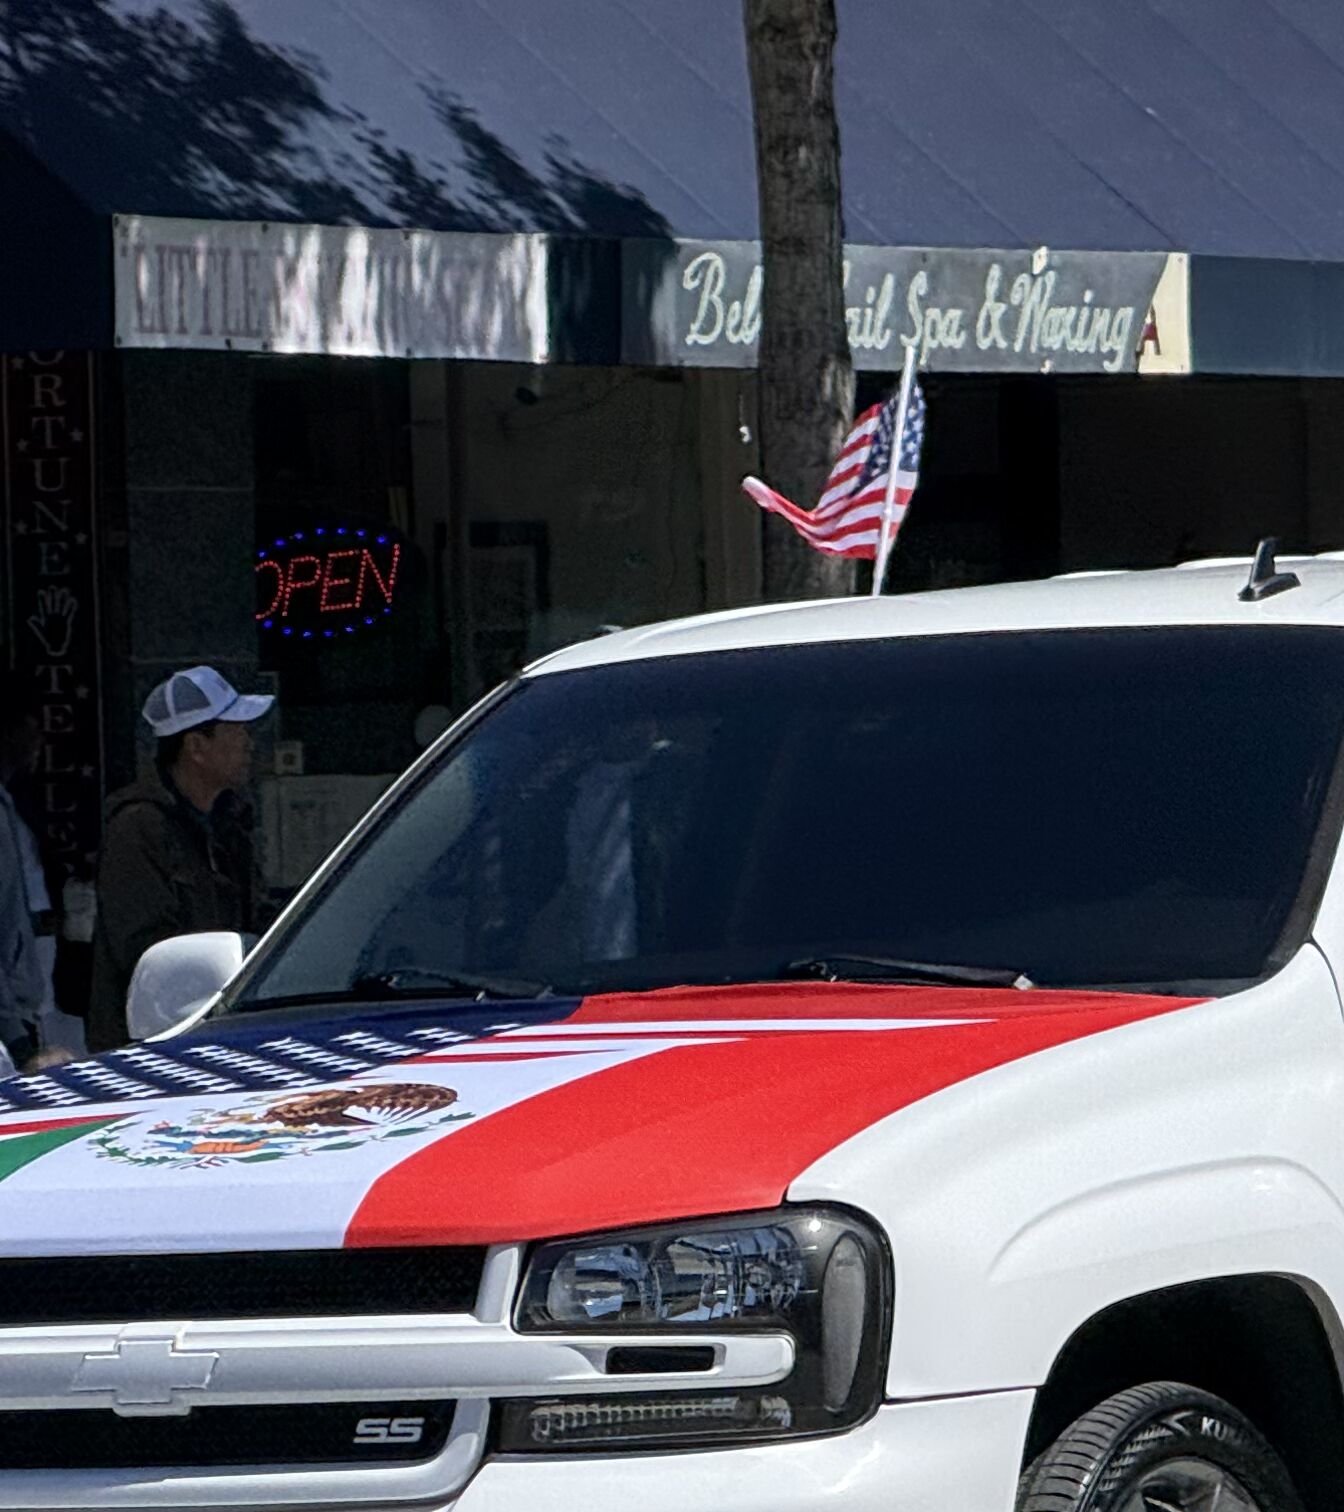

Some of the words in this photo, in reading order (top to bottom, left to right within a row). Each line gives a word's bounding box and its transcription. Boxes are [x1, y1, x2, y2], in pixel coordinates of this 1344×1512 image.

[683, 251, 762, 346] Bel
[842, 260, 896, 351] ail
[900, 269, 966, 368] Spa
[975, 262, 1008, 350] &
[1009, 268, 1134, 372] Waxing
[29, 349, 74, 577] RTUNE
[254, 543, 401, 620] OPEN
[352, 1416, 426, 1445] SS
